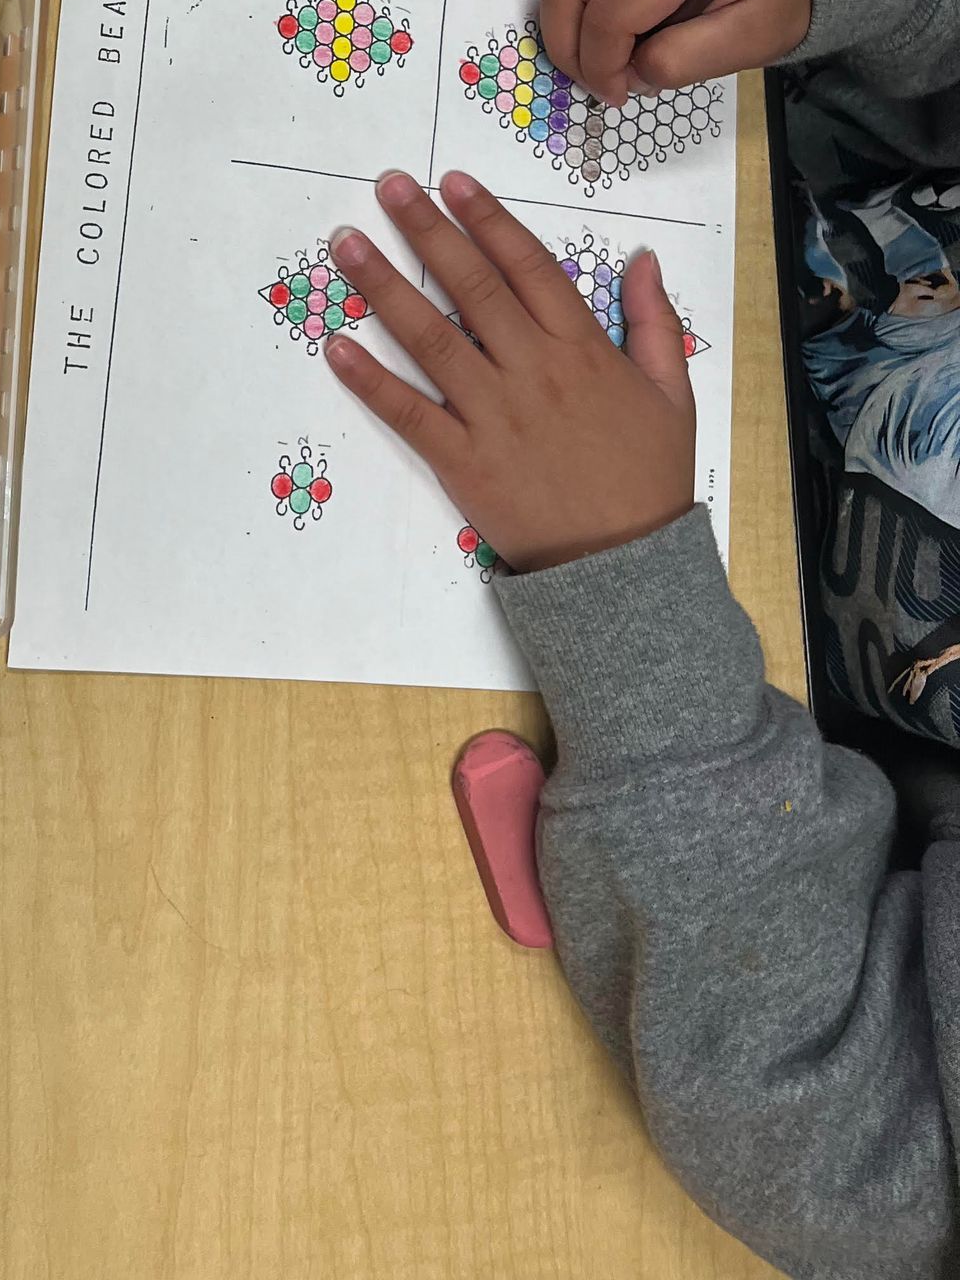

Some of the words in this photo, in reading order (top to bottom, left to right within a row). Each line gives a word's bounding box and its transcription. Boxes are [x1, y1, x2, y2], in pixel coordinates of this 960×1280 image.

[76, 101, 115, 265] COLORED
[295, 248, 307, 257] 2
[63, 305, 94, 374] THE
[297, 434, 309, 445] 2
